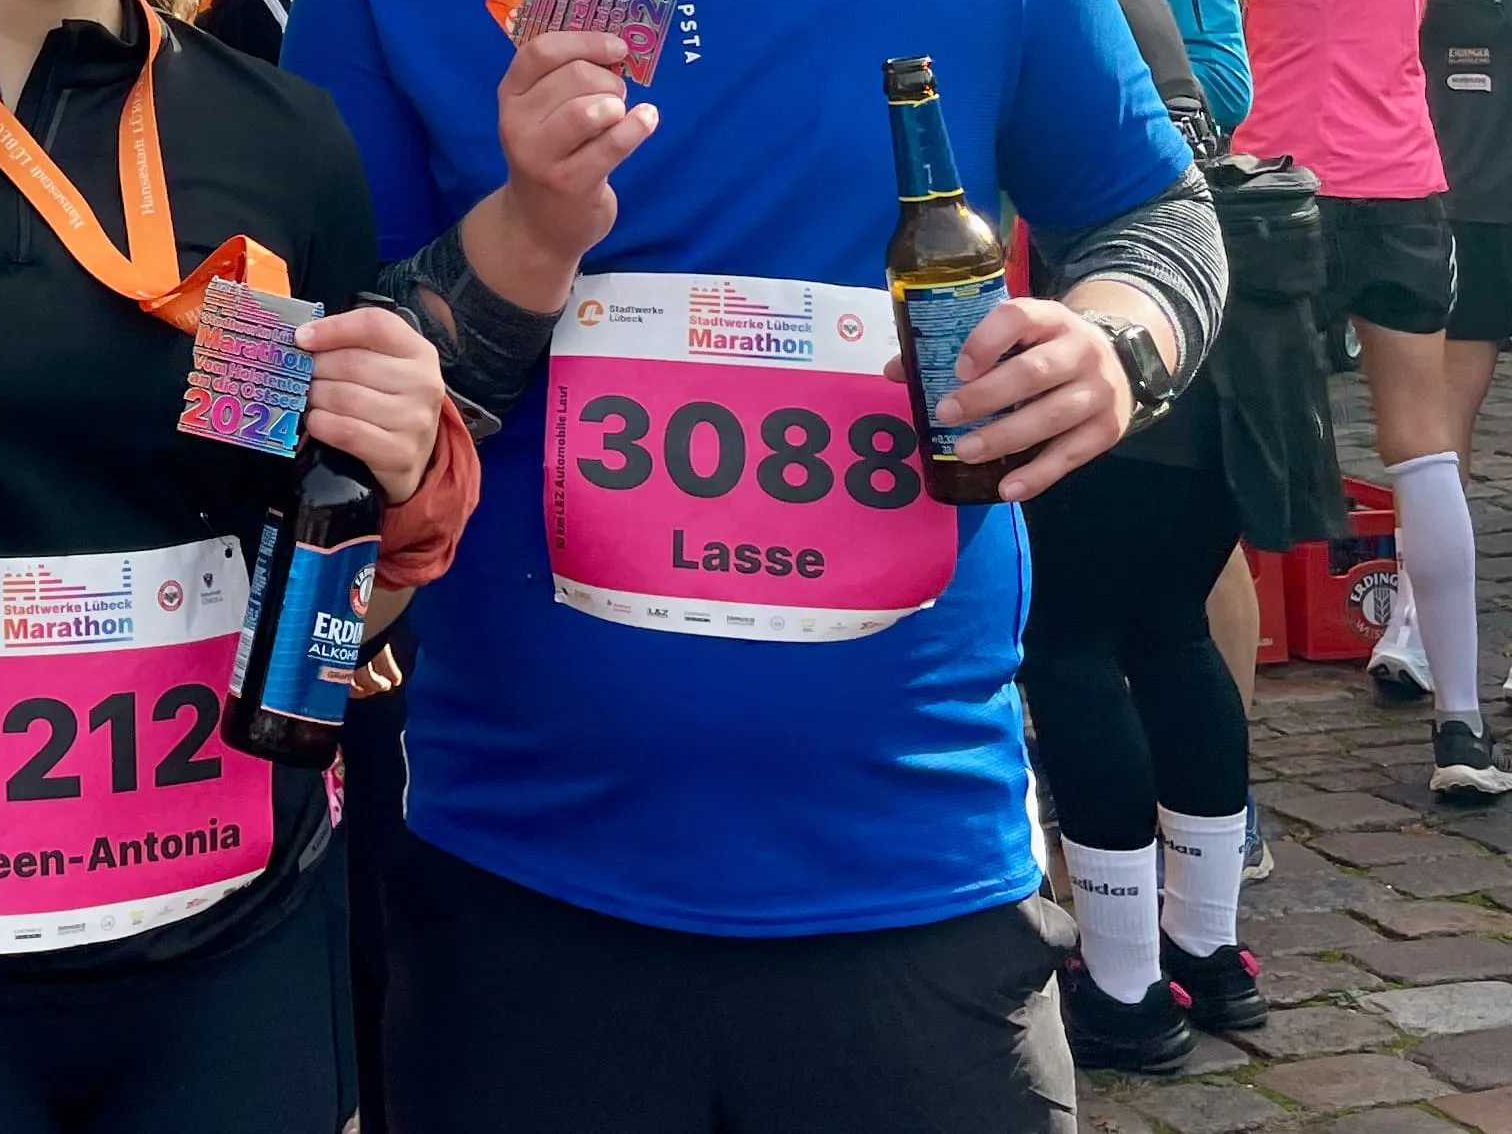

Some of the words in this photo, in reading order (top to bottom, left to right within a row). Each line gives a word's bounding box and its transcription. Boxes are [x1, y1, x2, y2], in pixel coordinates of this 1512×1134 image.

[609, 304, 664, 315] Stadtwerke
[609, 314, 644, 324] Lübeck
[689, 315, 763, 331] Stadtwerke
[766, 319, 813, 334] Lübeck
[196, 324, 314, 374] Marathon
[688, 328, 813, 356] Marathon
[193, 353, 228, 376] Vom
[187, 372, 211, 388] an
[559, 386, 569, 414] Lauf
[180, 387, 299, 450] 2024
[555, 417, 567, 490] Automobile
[576, 394, 921, 510] 3088
[672, 529, 826, 579] Lasse
[1350, 572, 1398, 603] ERDING
[3, 602, 82, 615] Stadtwerke
[84, 598, 132, 613] Lübeck
[4, 615, 133, 640] Marathon
[307, 644, 359, 662] ALKOH
